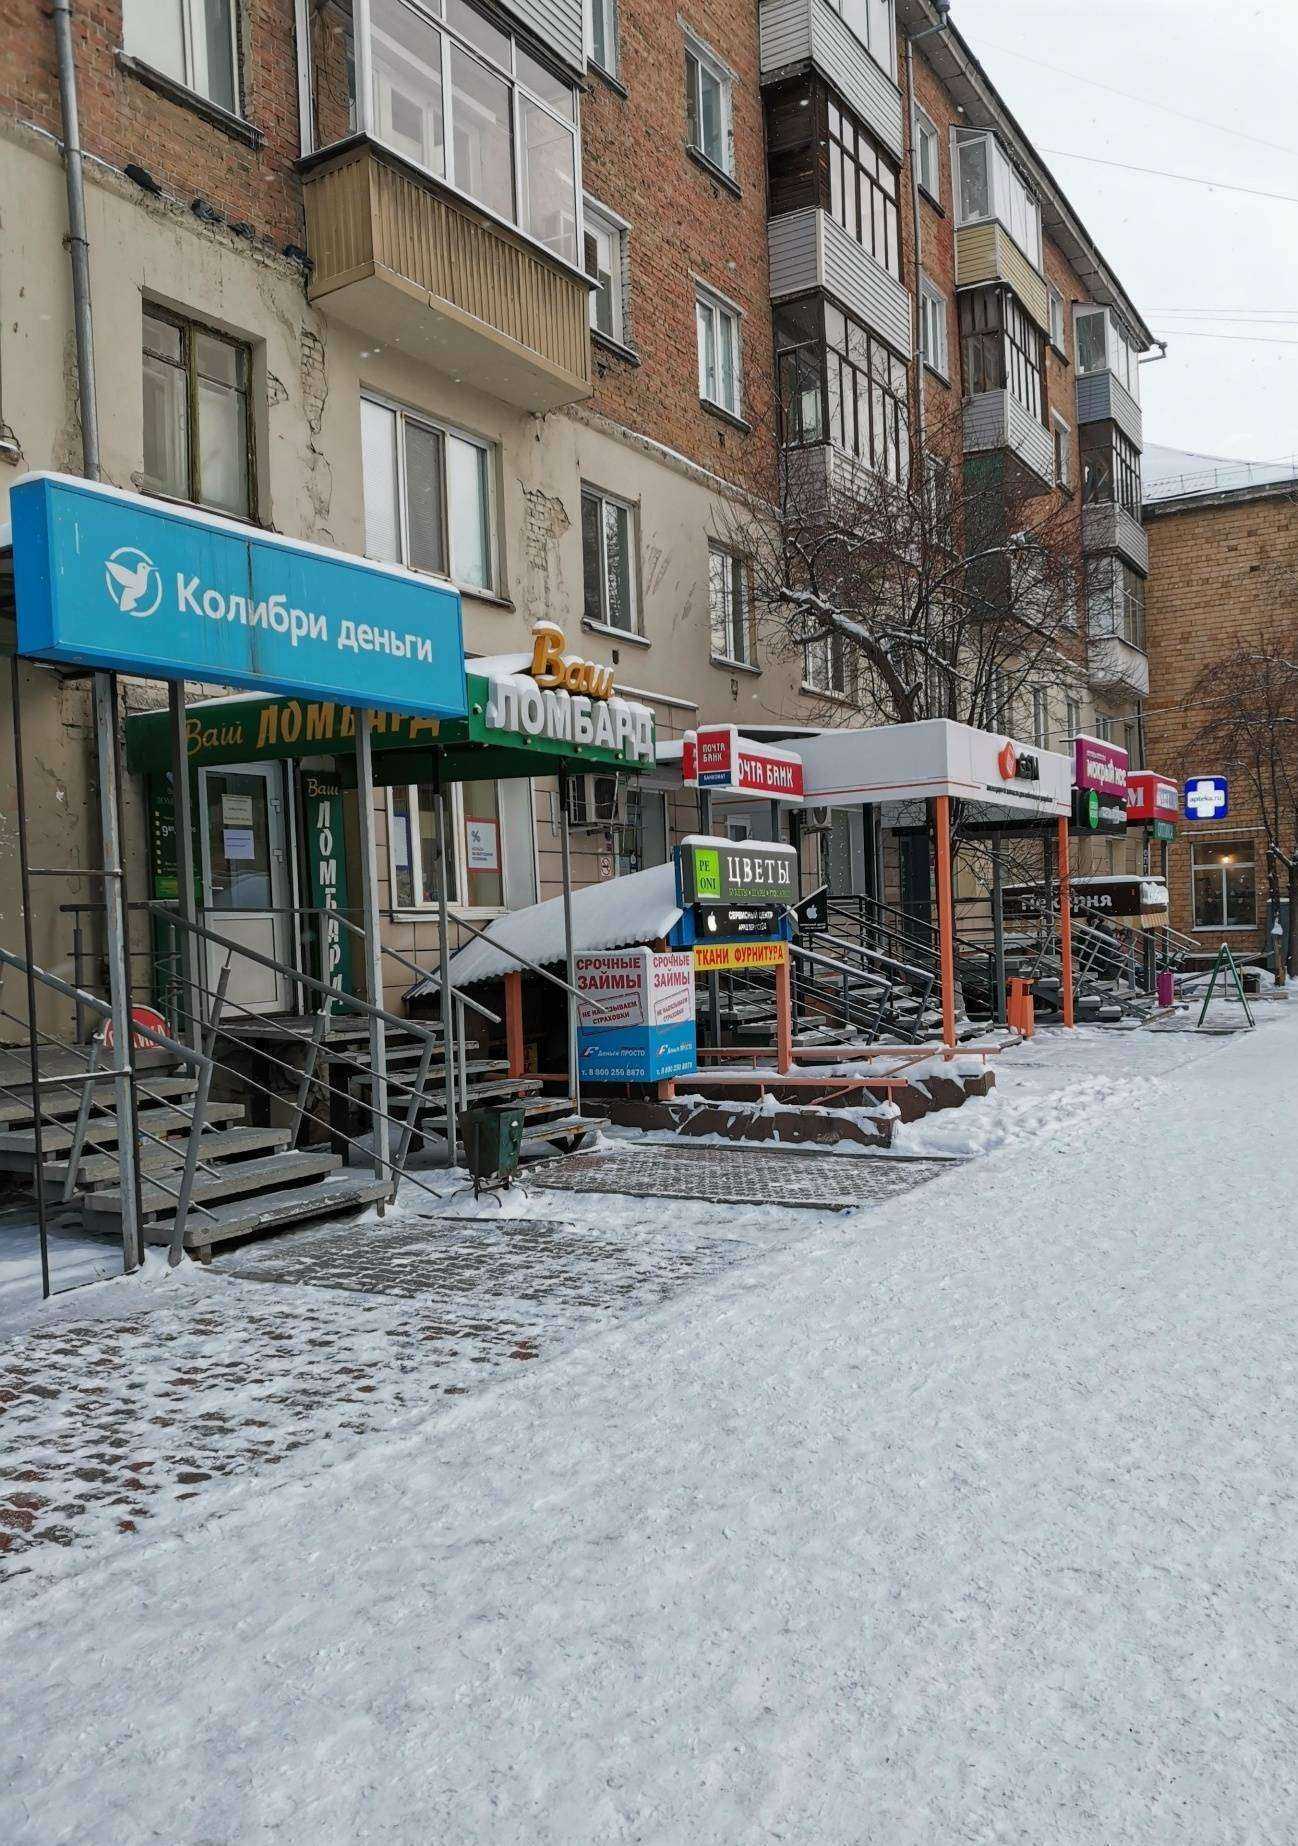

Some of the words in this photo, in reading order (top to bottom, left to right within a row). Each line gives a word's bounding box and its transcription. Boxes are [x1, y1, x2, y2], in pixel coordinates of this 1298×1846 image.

[177, 572, 328, 647] Колибри
[337, 619, 433, 663] деньги
[532, 626, 614, 699] Ваш
[486, 676, 656, 765] ЛОМБАРД
[183, 718, 244, 755] Ваш
[702, 742, 726, 752] ПОЧТА
[703, 753, 722, 763] БАНК
[766, 764, 794, 788] БАНК
[306, 778, 339, 797] Ваш
[699, 859, 711, 872] PE
[727, 856, 791, 887] ЦВЕТЫ
[700, 877, 717, 890] ONI
[576, 956, 641, 971] СРОЧНЫЕ
[653, 955, 690, 969] СРОЧНЫЕ
[695, 948, 729, 966] ТКАНИ
[734, 944, 784, 962] ФУРНИТУРА
[577, 970, 642, 990] ЗАЙМЫ
[654, 968, 690, 988] ЗАЙМЫ
[592, 1011, 630, 1025] СТРАХОВКИ
